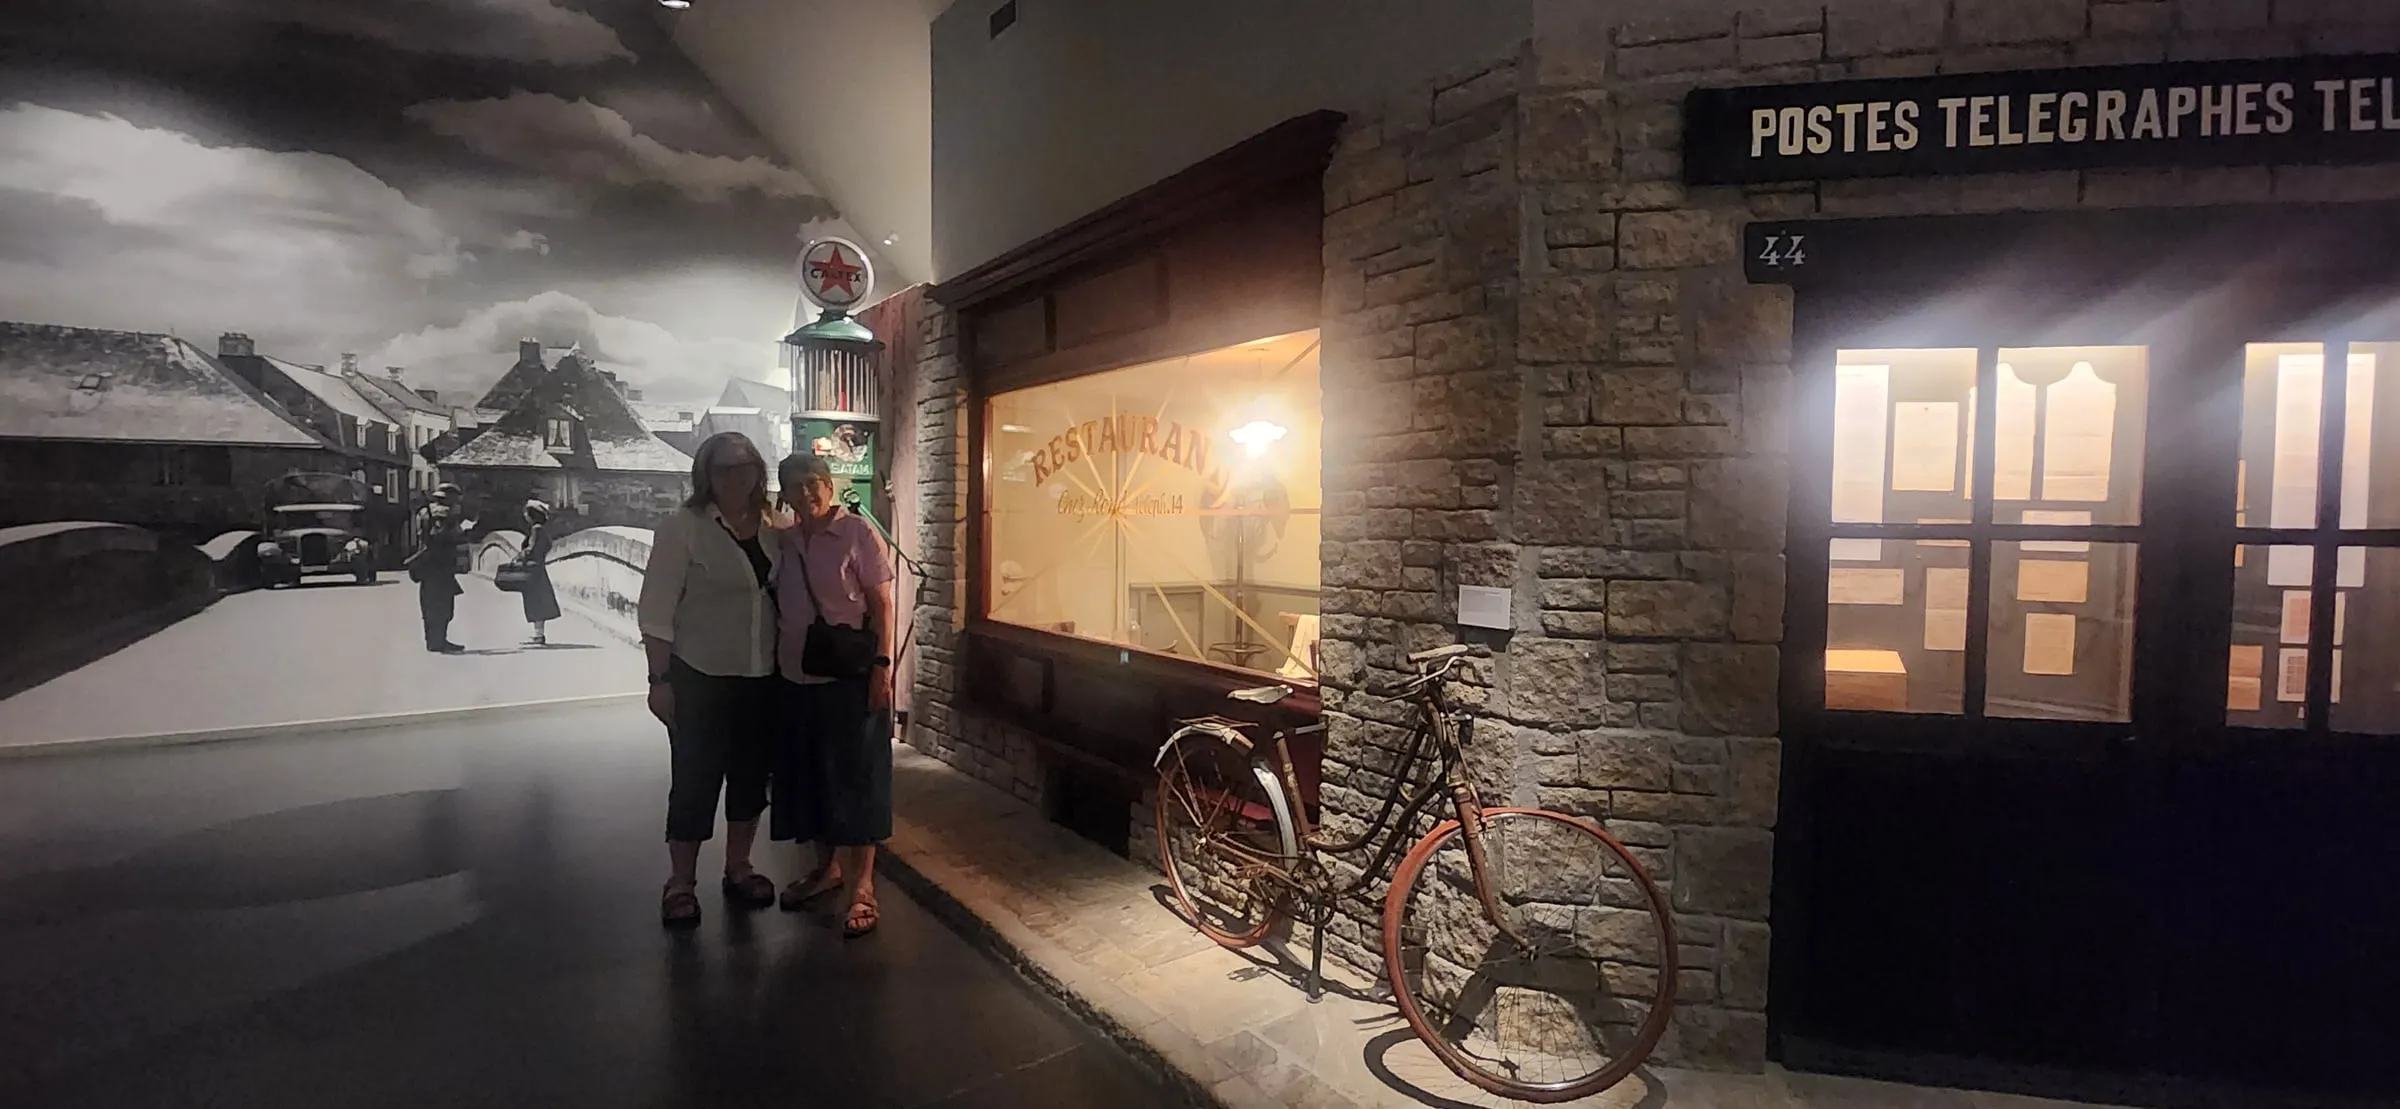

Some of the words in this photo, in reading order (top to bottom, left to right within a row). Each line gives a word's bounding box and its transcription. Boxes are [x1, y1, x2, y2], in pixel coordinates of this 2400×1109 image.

[1751, 100, 1919, 157] POSTES
[1938, 82, 2294, 148] TELEGRAPHES
[2313, 77, 2400, 131] TEL
[1759, 235, 1806, 266] 44
[810, 268, 861, 283] CALTEX
[830, 462, 869, 475] SATAM
